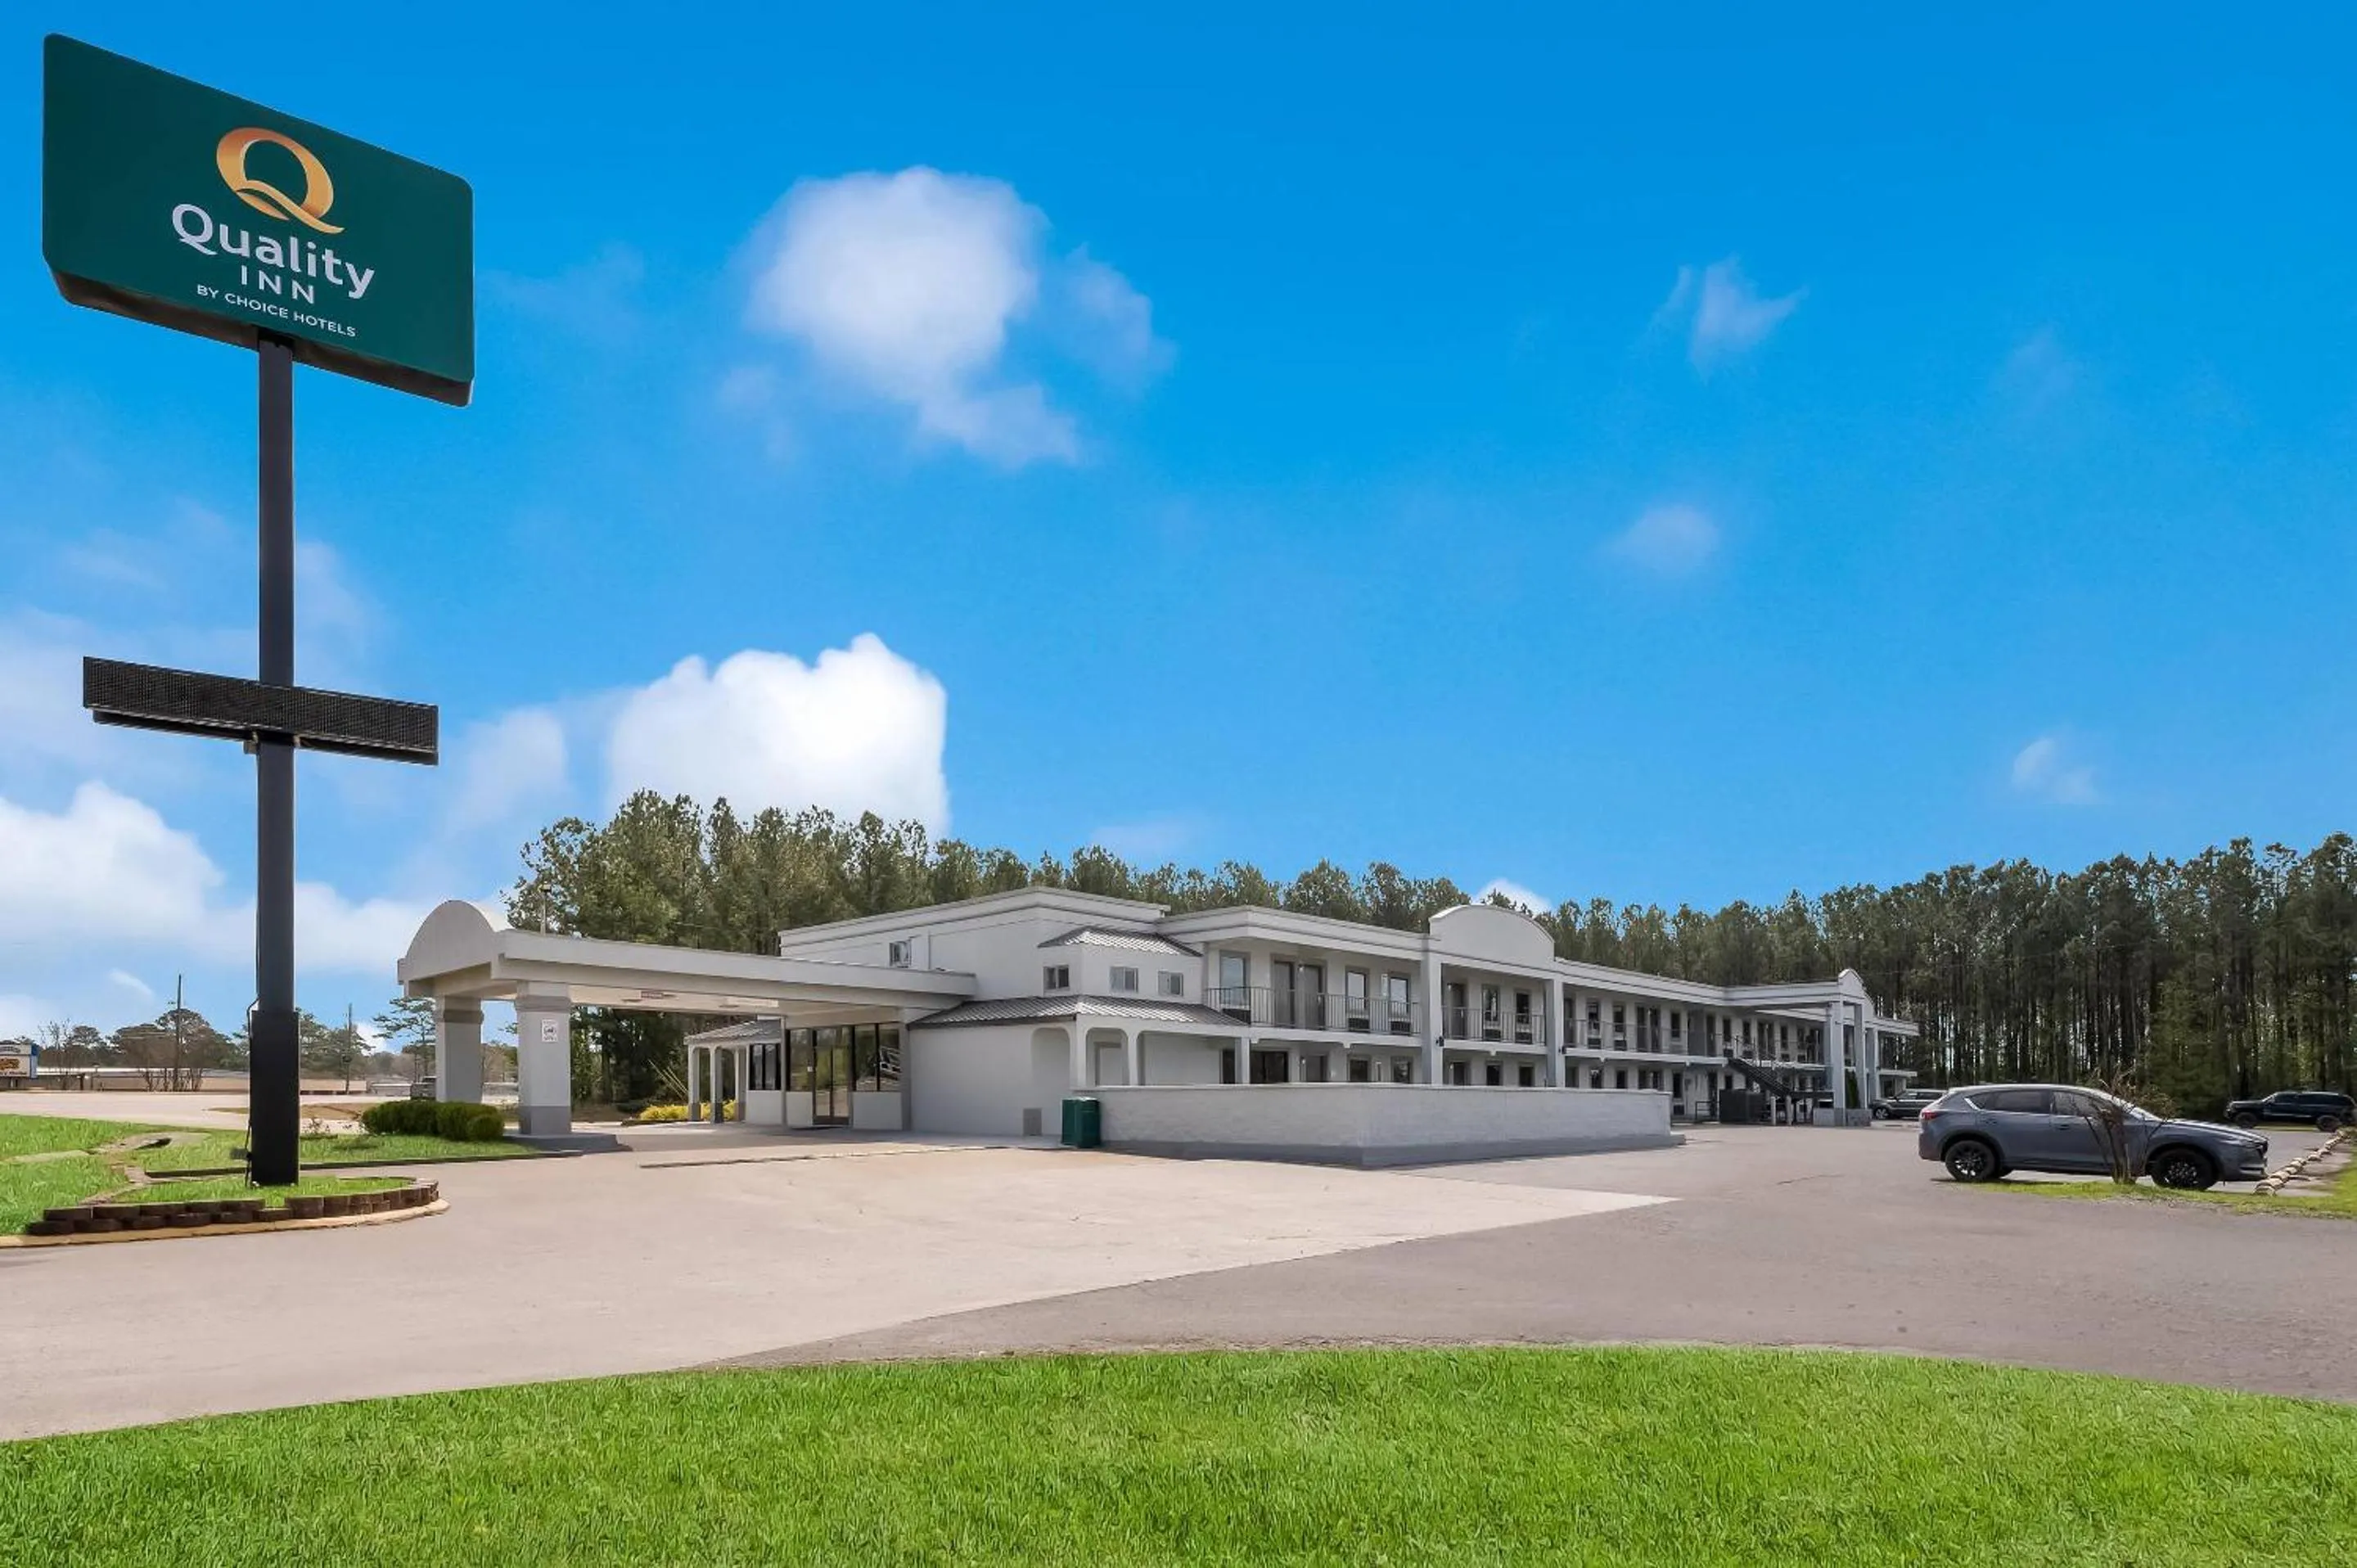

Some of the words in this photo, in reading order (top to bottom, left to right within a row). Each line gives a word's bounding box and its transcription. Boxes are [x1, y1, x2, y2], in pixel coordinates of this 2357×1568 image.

[172, 204, 375, 300] Quality
[196, 284, 219, 299] BY
[224, 292, 288, 318] CHOICE
[293, 311, 356, 337] HOTELS
[241, 264, 315, 304] INN
